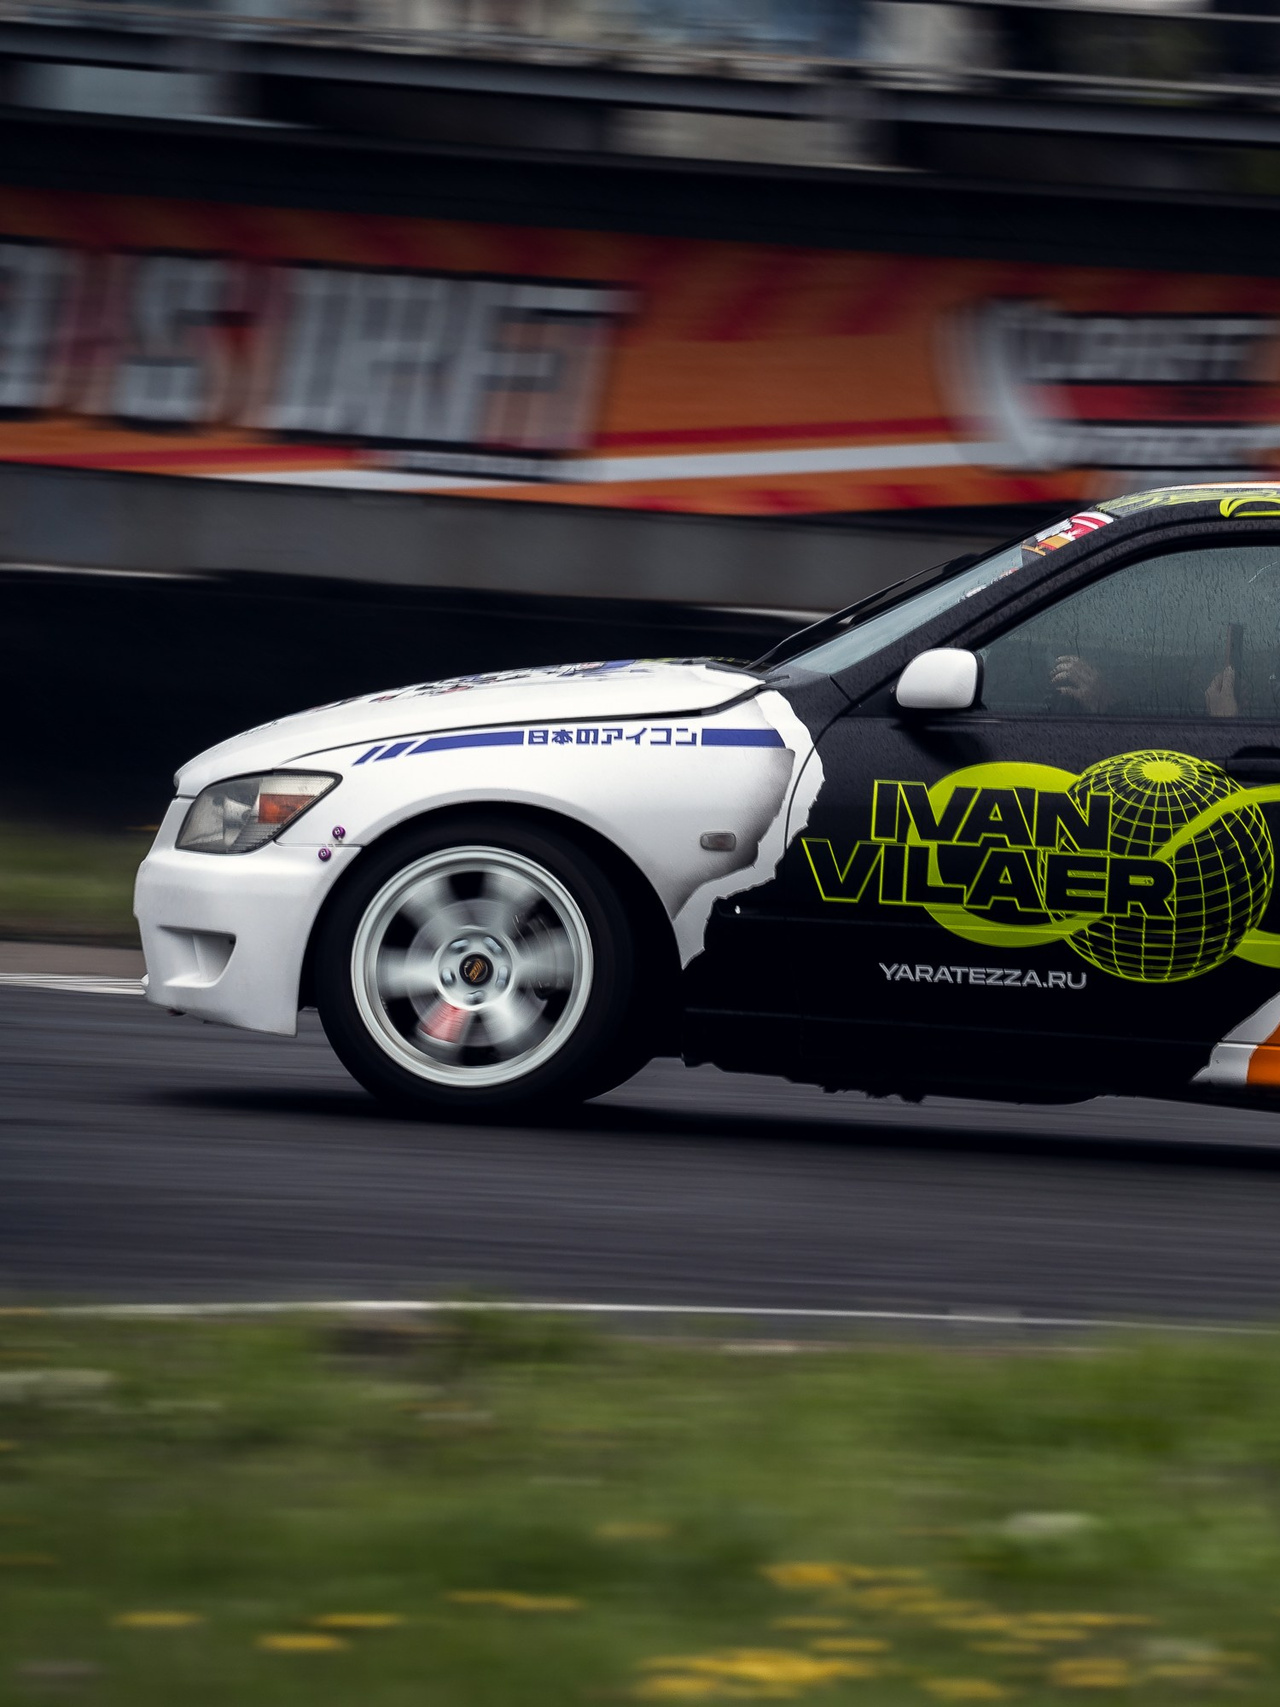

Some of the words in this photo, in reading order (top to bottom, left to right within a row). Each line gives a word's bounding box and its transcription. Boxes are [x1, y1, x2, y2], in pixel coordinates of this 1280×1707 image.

[528, 727, 697, 746] 日本のアイコン
[871, 779, 1114, 854] IVAN
[801, 837, 1177, 920] VILAER
[879, 962, 1087, 990] YARATEZZA.RU
